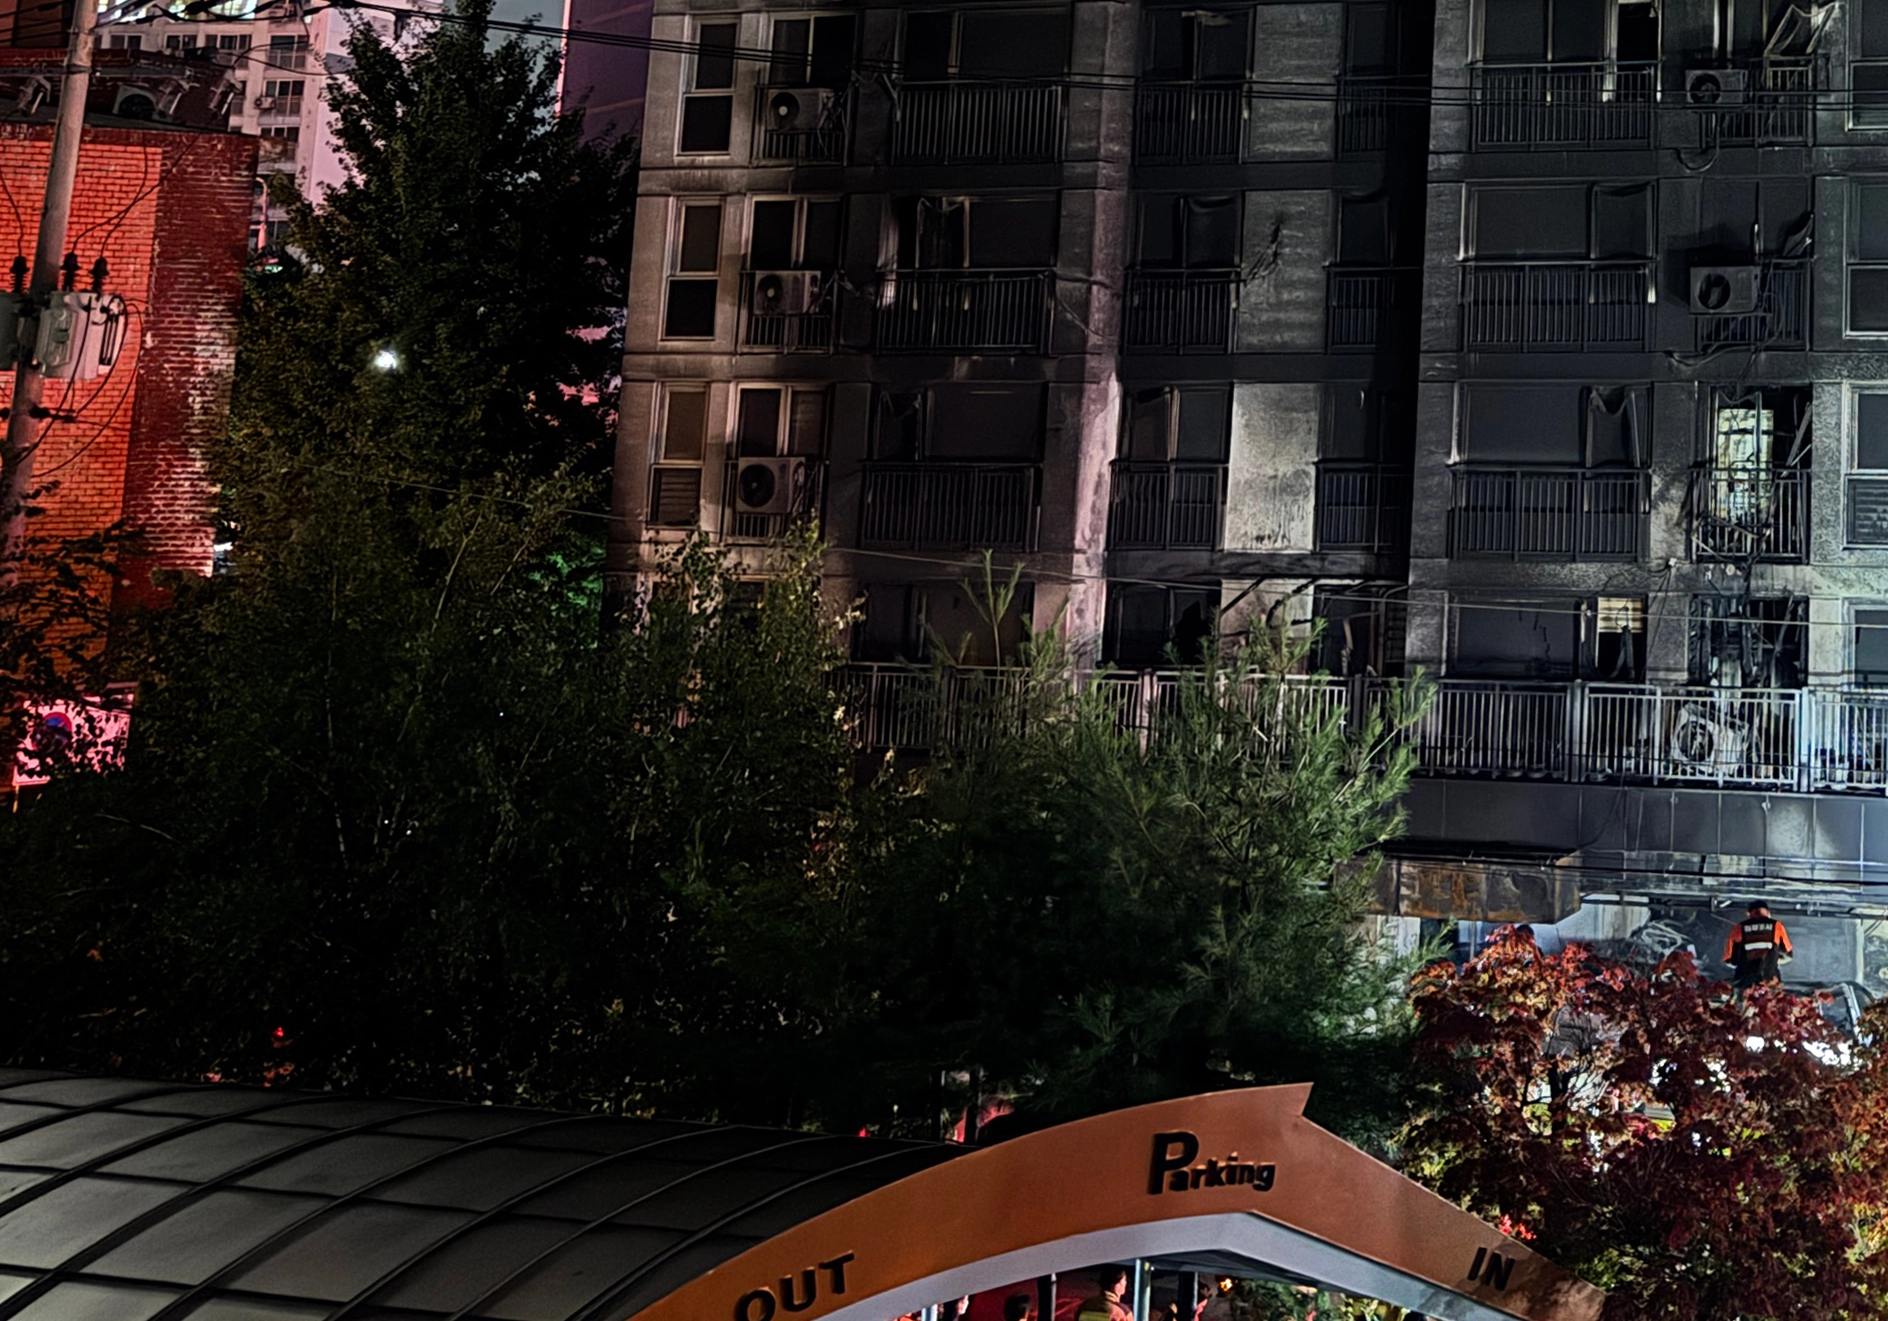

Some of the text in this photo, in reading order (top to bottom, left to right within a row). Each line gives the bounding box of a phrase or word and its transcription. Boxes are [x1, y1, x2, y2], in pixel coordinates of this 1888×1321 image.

[1148, 1131, 1276, 1195] Parking
[734, 1250, 855, 1321] OUT
[1467, 1247, 1516, 1291] IN
